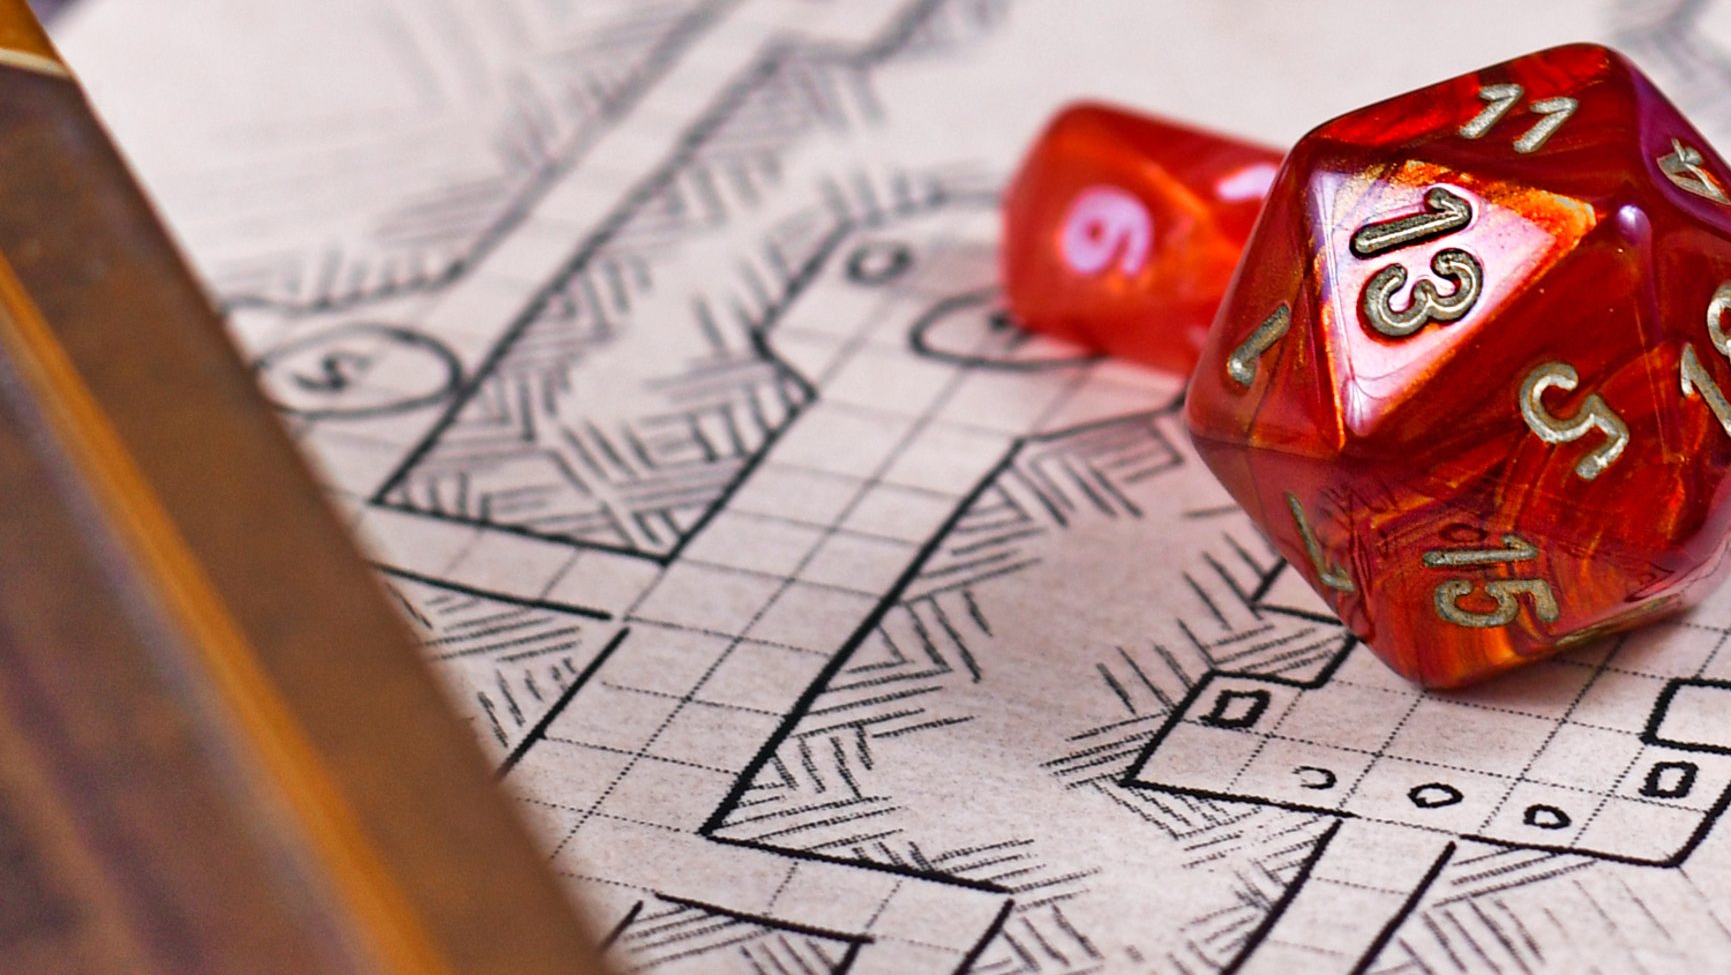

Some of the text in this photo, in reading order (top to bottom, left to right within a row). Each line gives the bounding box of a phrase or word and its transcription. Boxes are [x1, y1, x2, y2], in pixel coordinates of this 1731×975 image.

[1460, 82, 1579, 155] 11
[1349, 184, 1485, 340] 13
[1518, 361, 1630, 481] 5
[1422, 534, 1561, 629] 15
